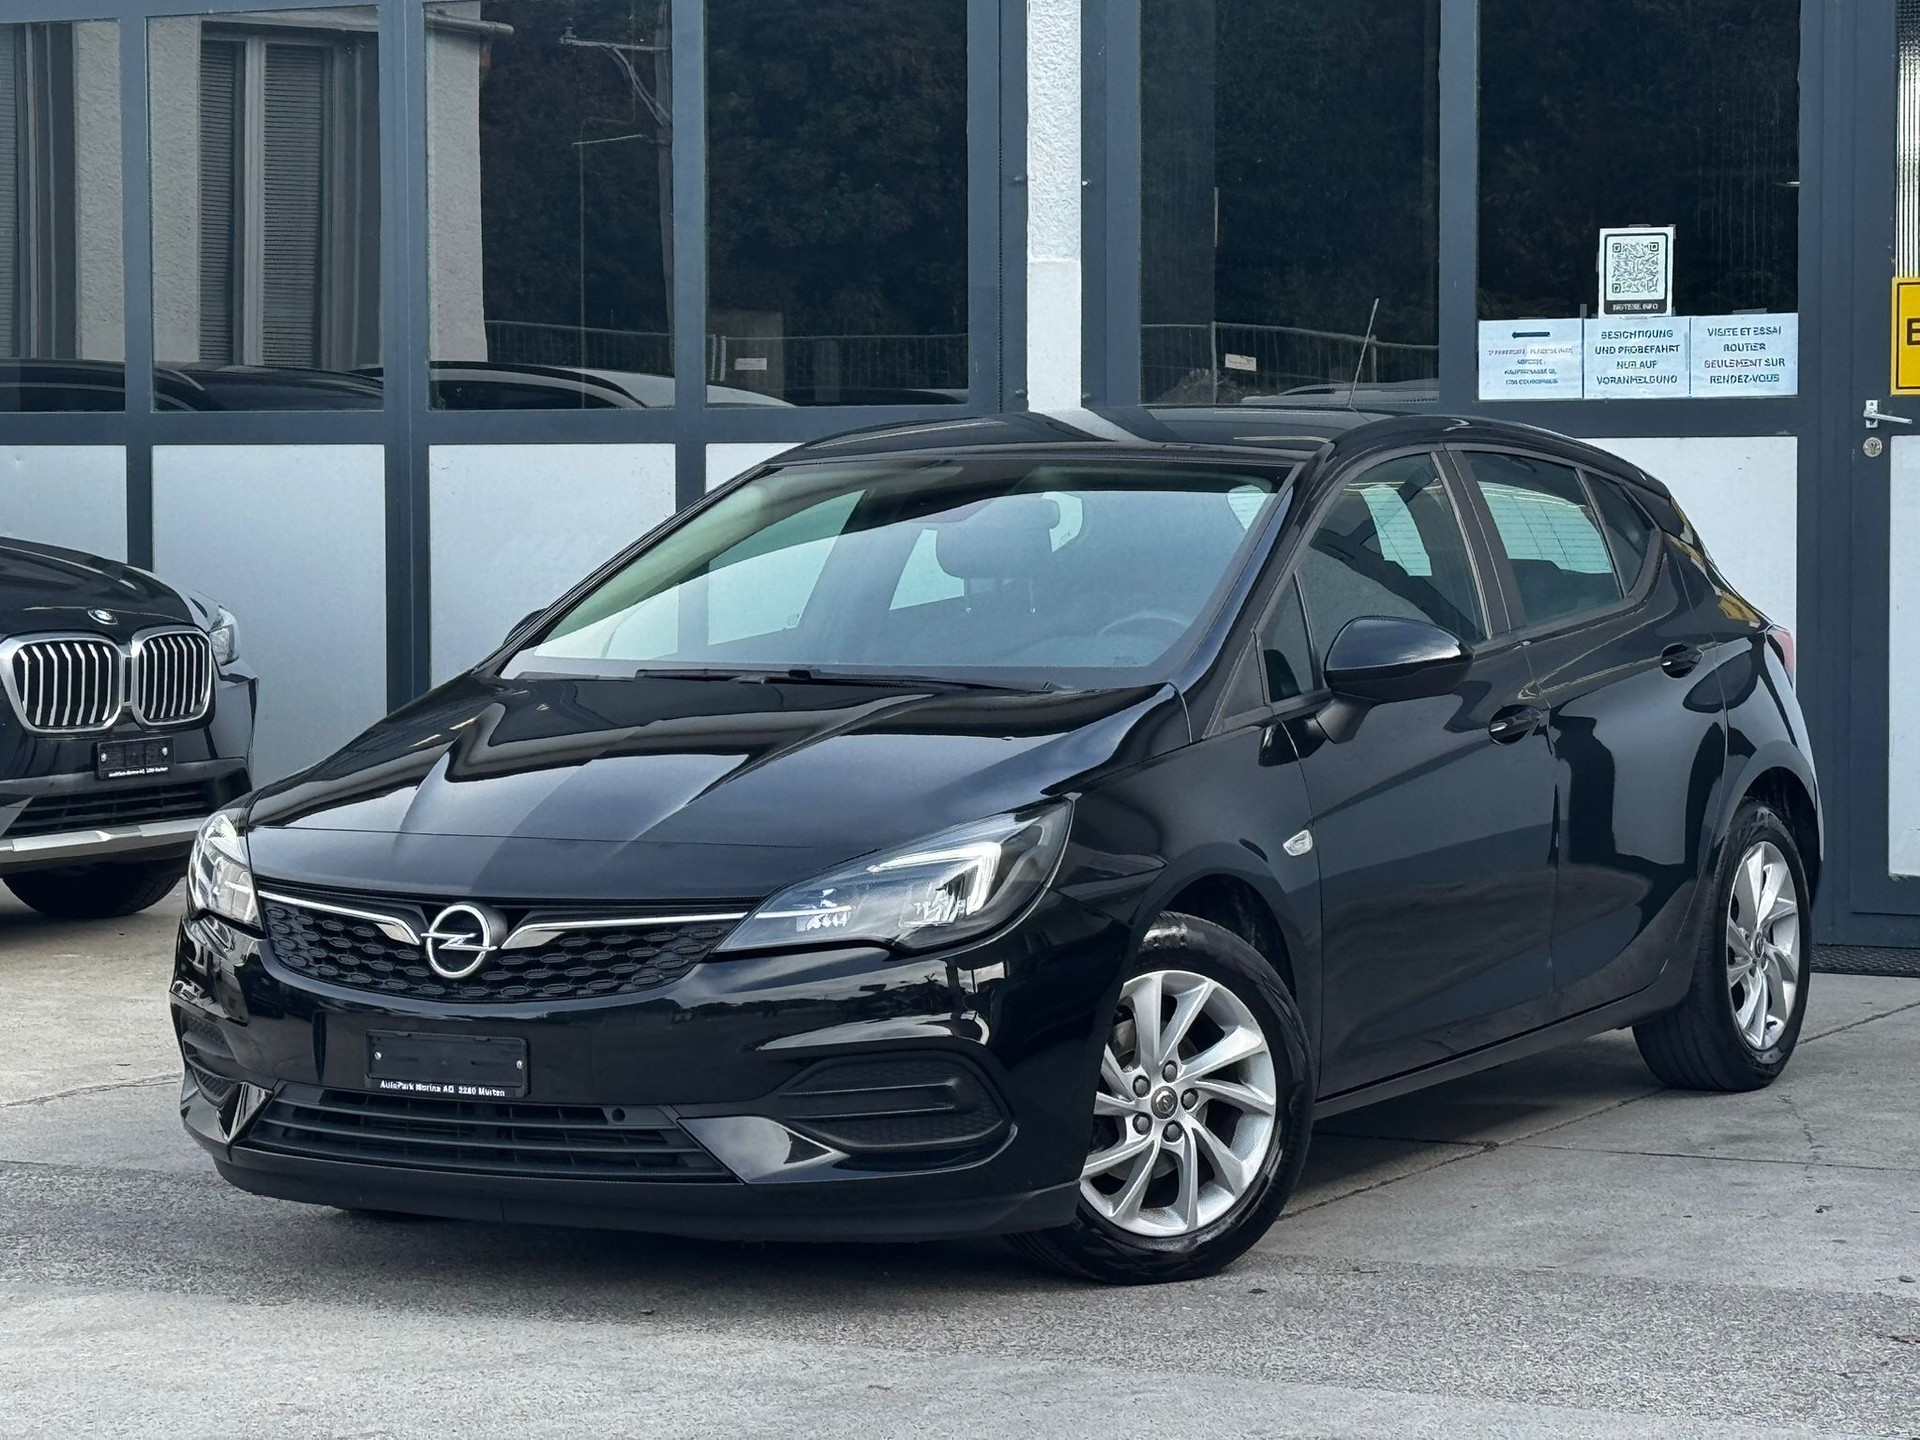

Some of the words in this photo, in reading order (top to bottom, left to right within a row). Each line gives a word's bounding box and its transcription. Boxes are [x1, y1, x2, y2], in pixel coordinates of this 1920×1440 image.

[1740, 328, 1751, 336] ET
[1753, 326, 1781, 335] ESSAI
[1594, 346, 1616, 354] UND
[1618, 344, 1680, 354] PROBEFAHRT
[1639, 360, 1657, 368] AUF
[1704, 359, 1761, 368] SEULEMENT
[1763, 358, 1785, 367] SUR
[380, 1080, 414, 1091] AutoPark
